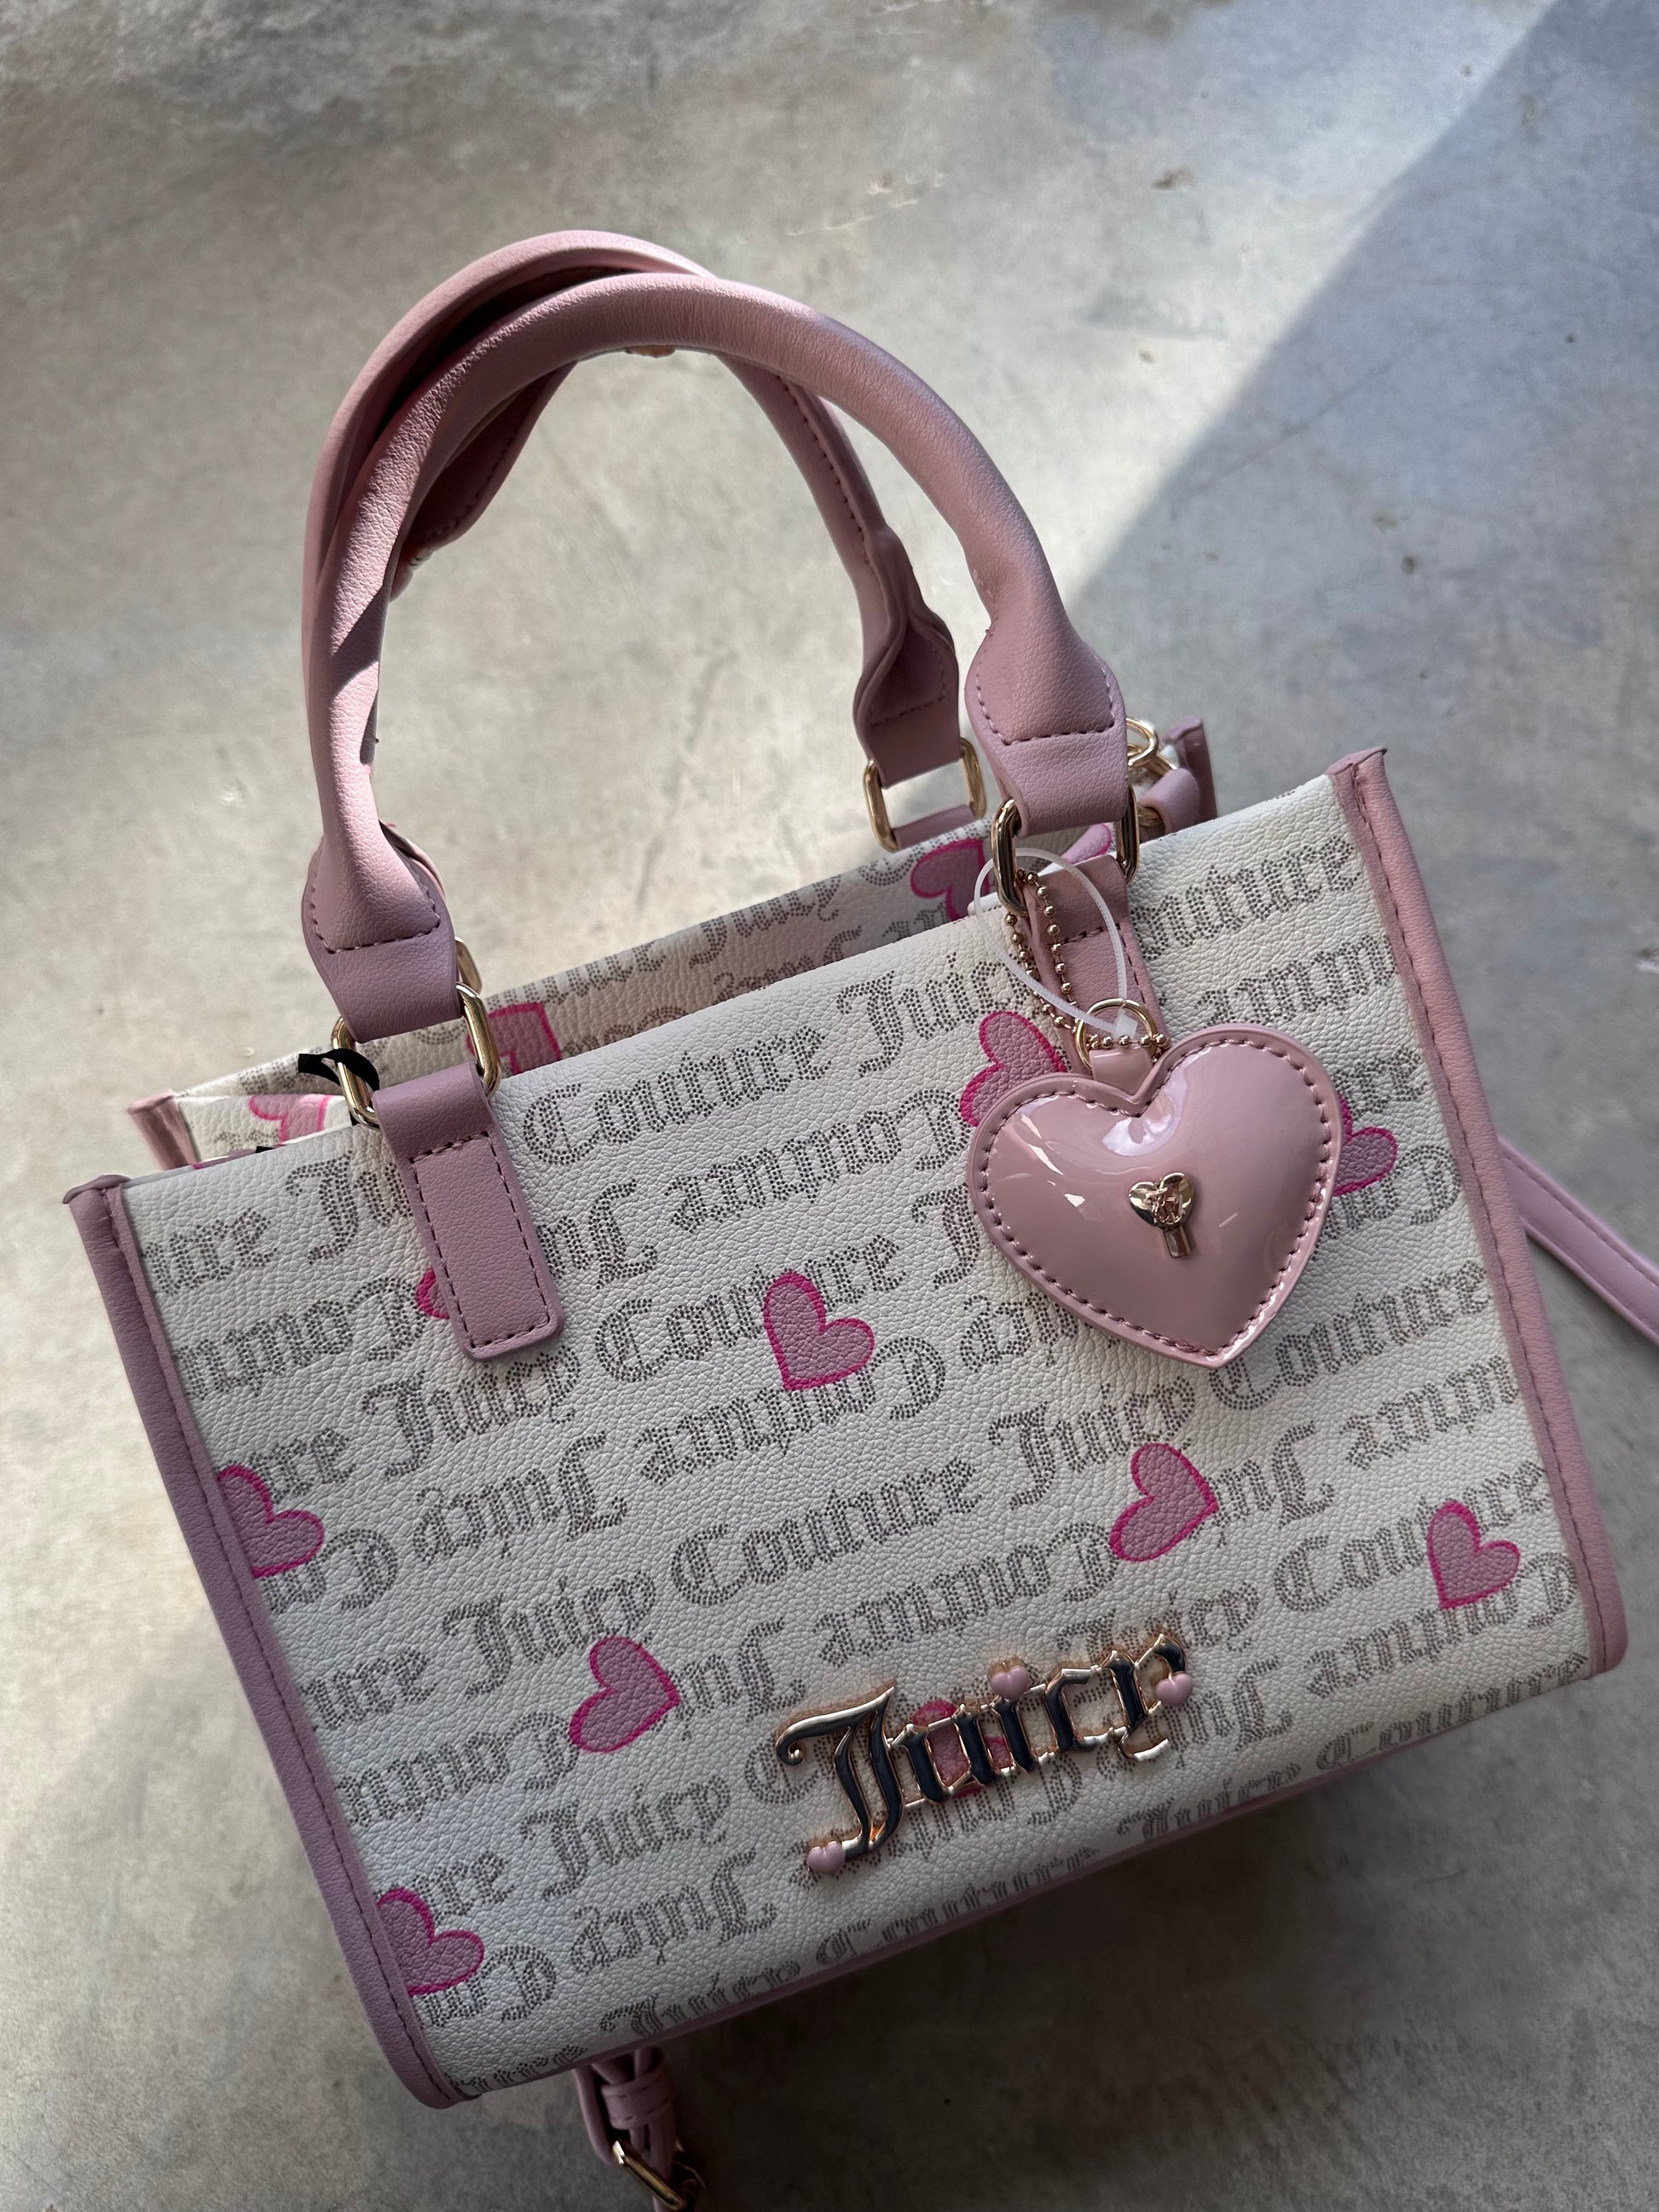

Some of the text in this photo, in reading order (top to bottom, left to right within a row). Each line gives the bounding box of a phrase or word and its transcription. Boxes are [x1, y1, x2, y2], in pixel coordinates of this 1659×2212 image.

[523, 1025, 830, 1165] Couture
[1131, 835, 1360, 959] outure
[182, 936, 1397, 1399] uture Couture Coutu
[363, 1344, 581, 1476] Juicy
[598, 1235, 905, 1382] Coure
[1343, 1356, 1519, 1465] uture
[413, 1432, 627, 1556] Juicy
[442, 1573, 656, 1696] Juicy
[676, 1458, 980, 1606] Couture
[991, 1376, 1195, 1508] Juicy
[813, 1523, 1116, 1667] Couture
[340, 1712, 579, 1825] Coutu
[519, 1776, 731, 1900] Juicy
[1280, 1458, 1548, 1613] Coure
[776, 1635, 1190, 1867] Juicy
[570, 1853, 775, 1971] Juicy
